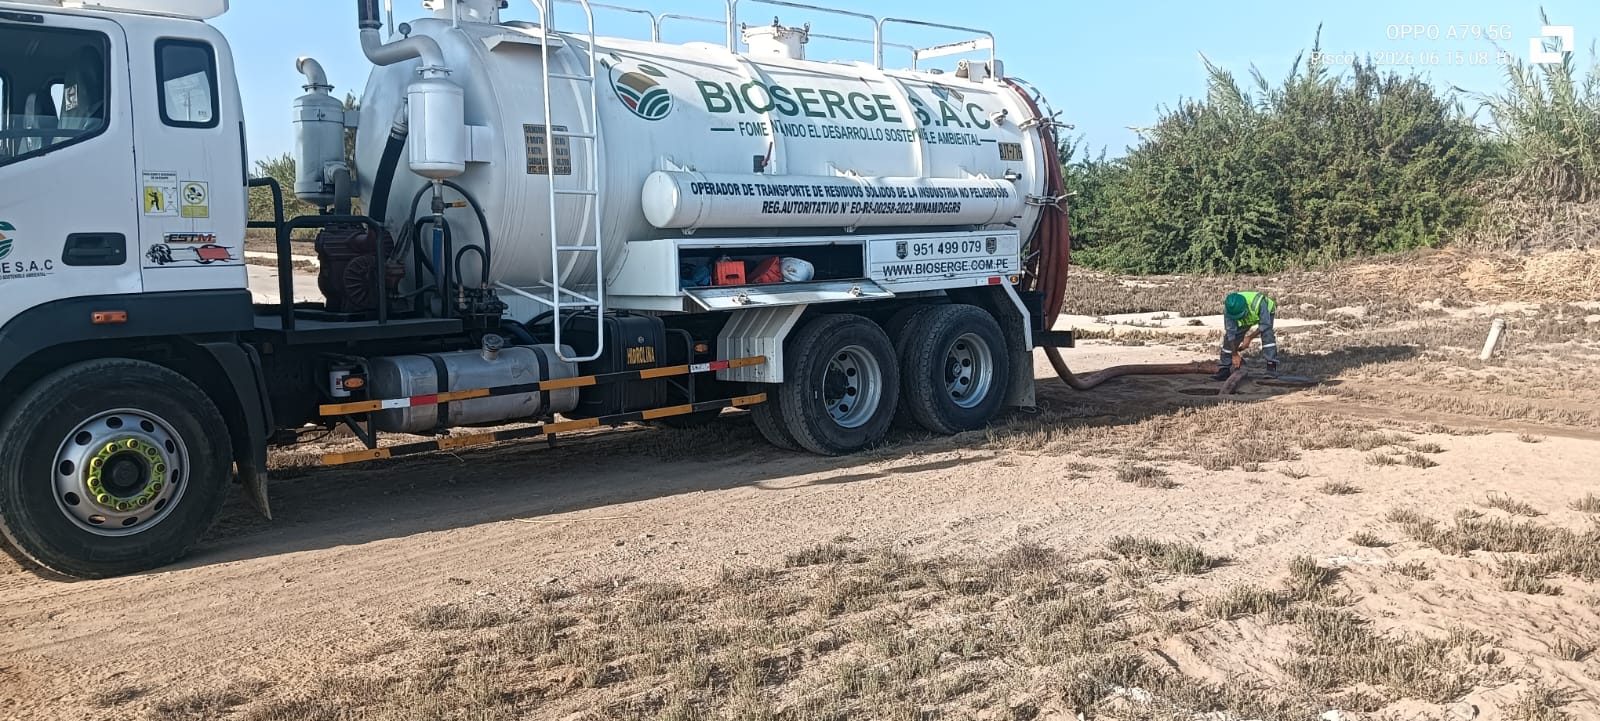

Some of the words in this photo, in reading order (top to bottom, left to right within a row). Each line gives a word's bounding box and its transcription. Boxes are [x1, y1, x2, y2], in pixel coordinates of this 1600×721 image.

[695, 80, 902, 123] BIOSERGE
[809, 125, 821, 138] EL
[823, 126, 883, 141] DESARROLLO
[938, 131, 981, 146] AMBIENTAL
[691, 182, 741, 196] OPERADOR
[742, 184, 754, 196] DE
[755, 184, 811, 197] TRANSPORTE
[812, 185, 823, 197] DE
[825, 185, 863, 198] RESIDUOS
[896, 187, 906, 198] DE
[908, 187, 917, 198] LA
[960, 188, 969, 199] NO
[970, 188, 1009, 199] PELIGROSOS
[762, 201, 838, 214] REG.AUTORITATIVO
[913, 243, 934, 256] 951
[937, 242, 959, 255] 499
[961, 240, 982, 253] 079
[0, 262, 11, 273] E
[15, 259, 53, 272] S.A.C
[883, 258, 1009, 276] WWW.BIOSERGE.COM.PE
